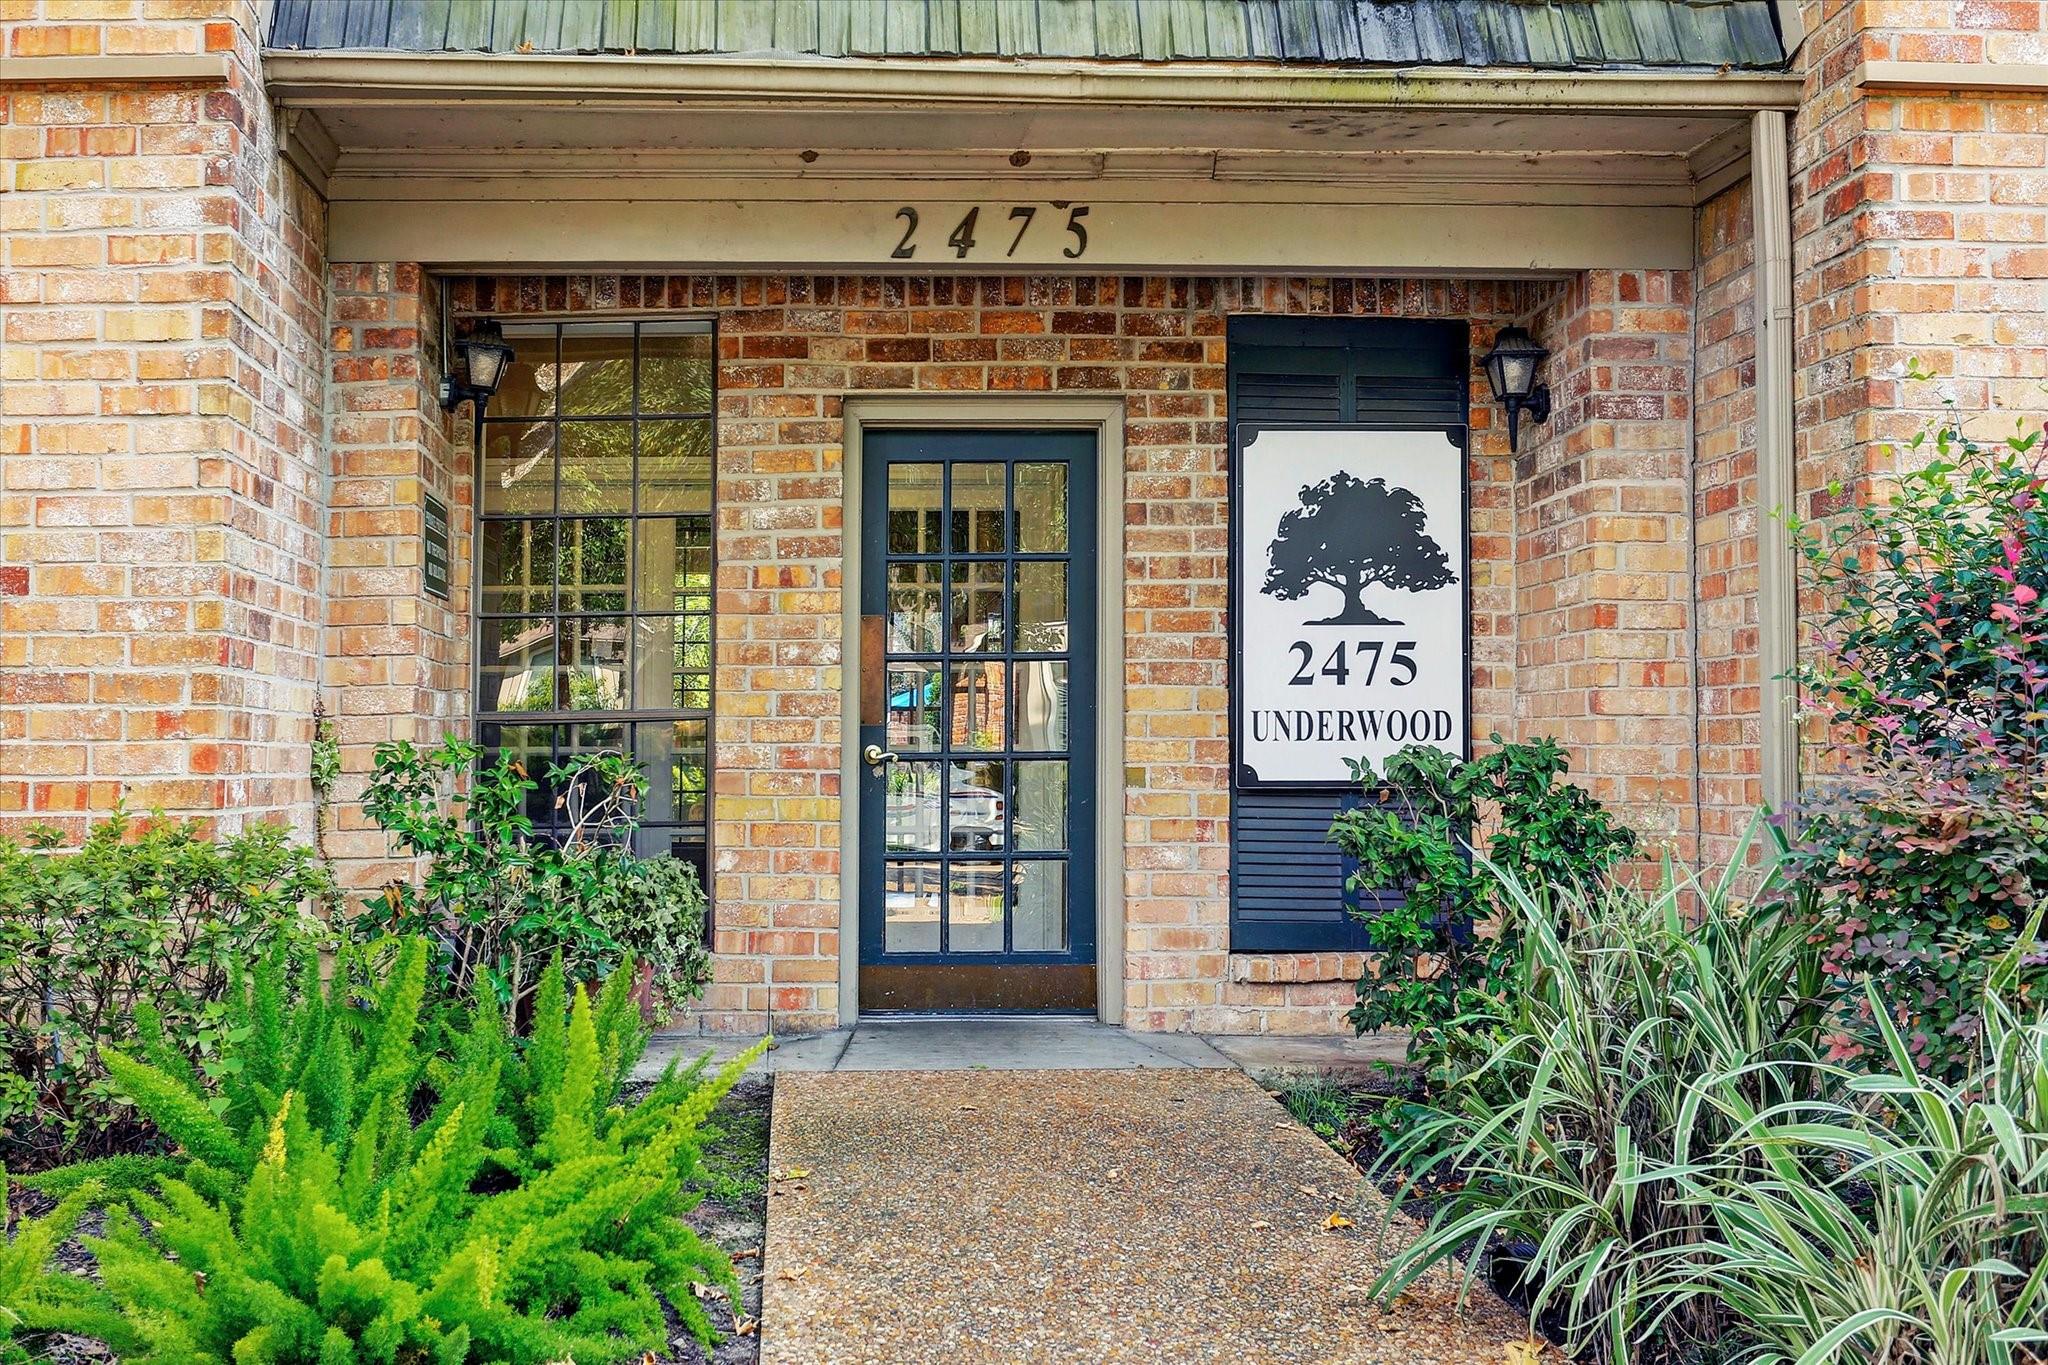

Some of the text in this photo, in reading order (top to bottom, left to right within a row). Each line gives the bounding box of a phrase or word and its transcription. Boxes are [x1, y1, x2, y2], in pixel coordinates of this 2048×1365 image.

[891, 206, 1090, 258] 2475
[1288, 640, 1418, 687] 2475
[1251, 709, 1453, 742] UNDERWOOD
